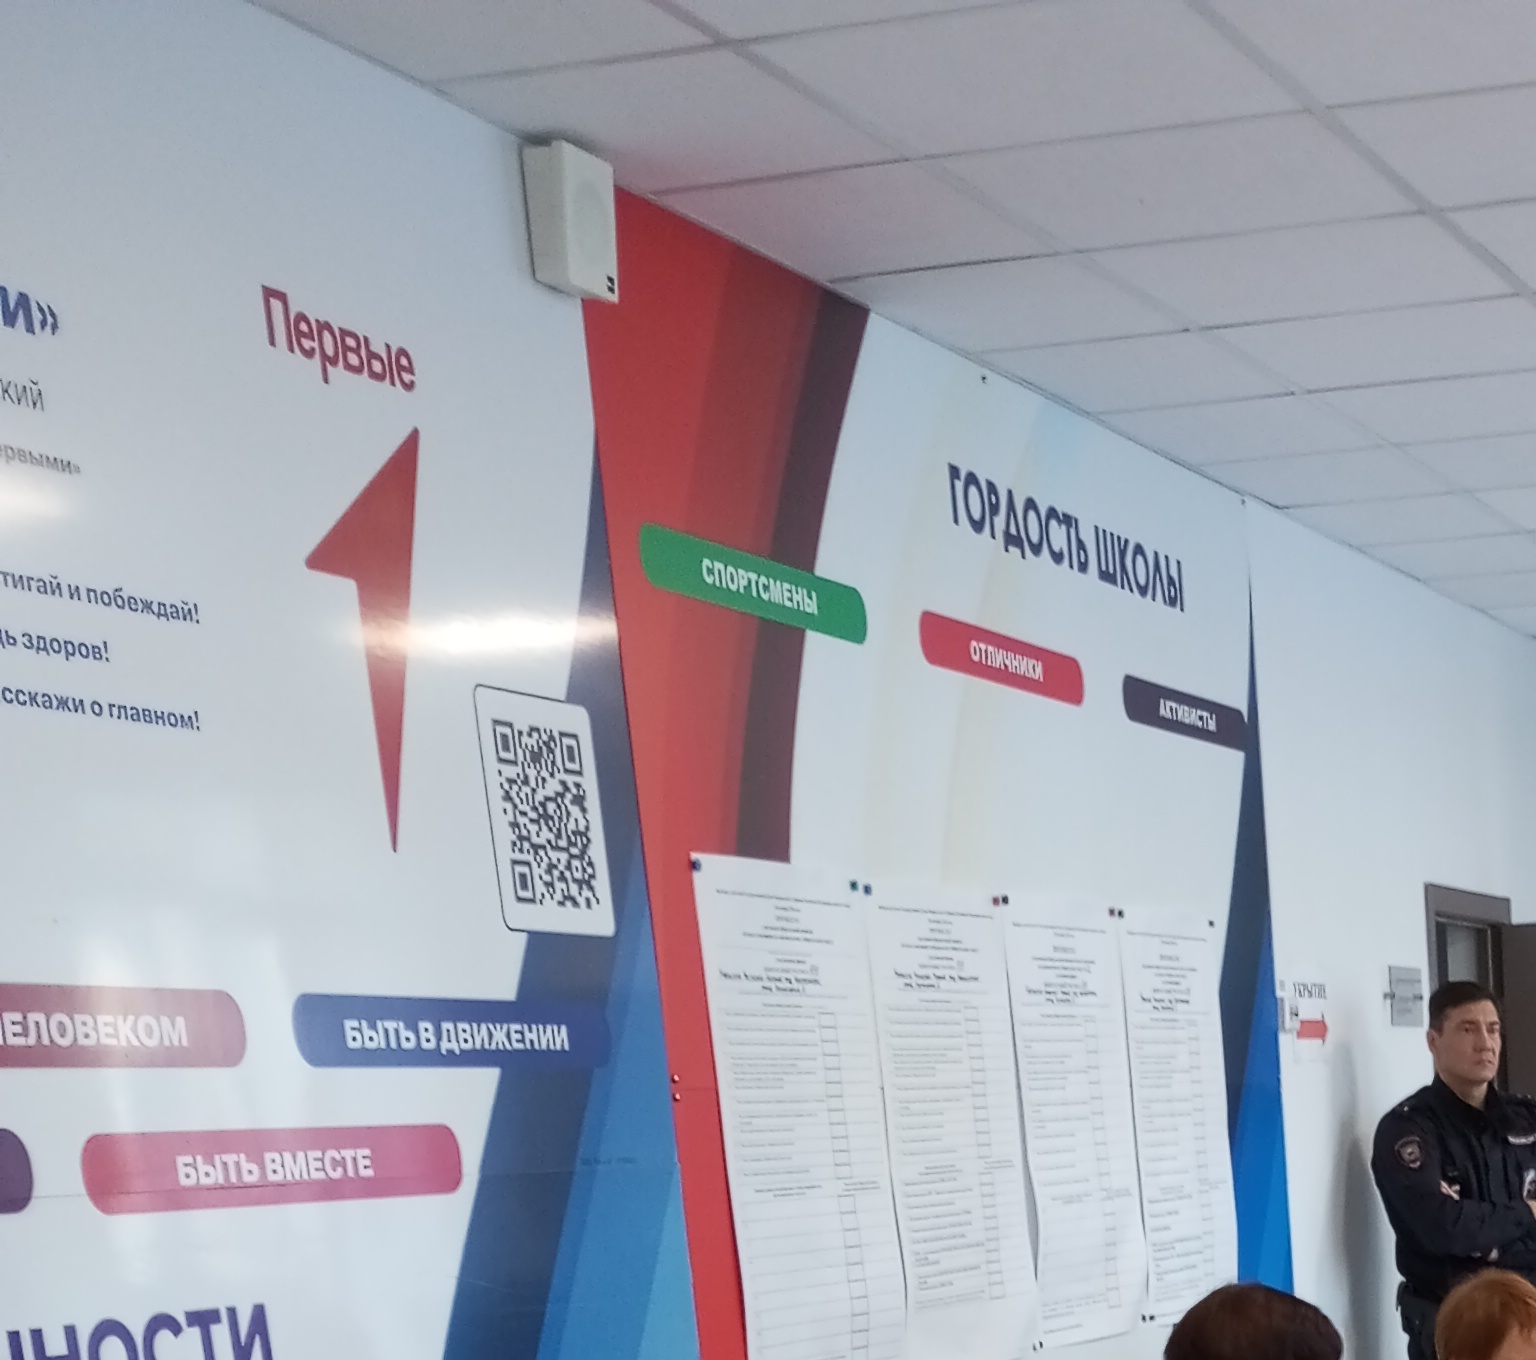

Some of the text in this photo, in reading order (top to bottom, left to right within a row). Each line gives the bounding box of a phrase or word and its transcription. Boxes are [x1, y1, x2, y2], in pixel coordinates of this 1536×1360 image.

[261, 285, 416, 392] Первые
[0, 445, 81, 475] рвыми»
[947, 462, 1185, 612] ГОРДОСТЬ ШКОЛЫ
[0, 570, 200, 625] тигай и побеждай!
[702, 558, 818, 617] СПОРТСМЕНЫ
[22, 632, 109, 662] здоров!
[969, 639, 1044, 684] ОТЛИЧНИКИ
[1, 686, 201, 732] сскажи о главном!
[1158, 697, 1217, 733] АКТИВИСТЫ
[344, 1018, 570, 1056] БЫТЬ В ДВИЖЕНИИ
[175, 1147, 374, 1187] БЫТЬ ВМЕСТЕ
